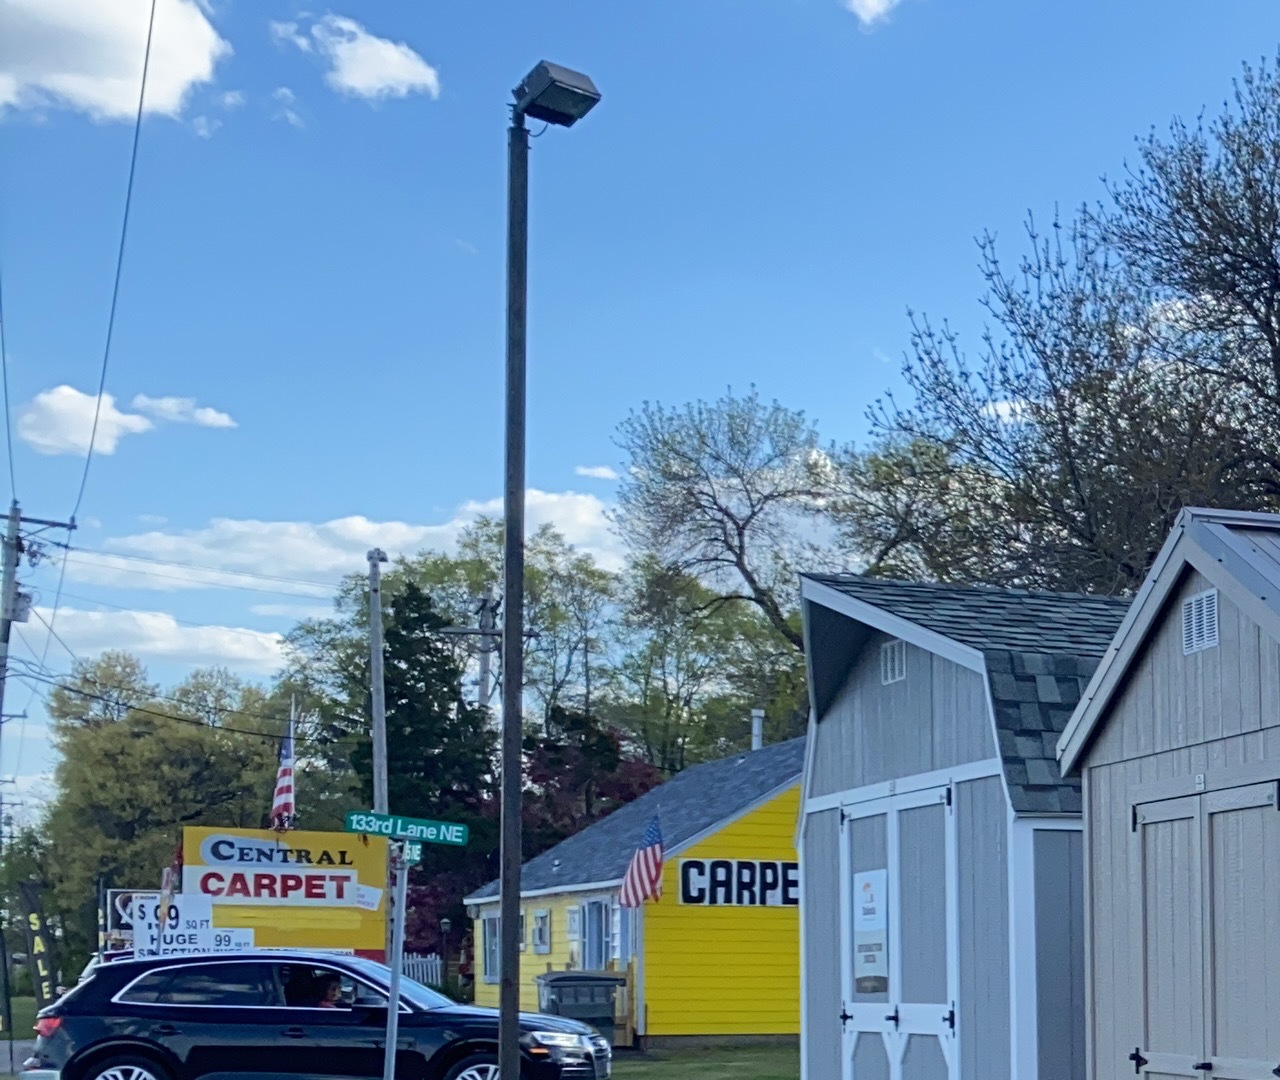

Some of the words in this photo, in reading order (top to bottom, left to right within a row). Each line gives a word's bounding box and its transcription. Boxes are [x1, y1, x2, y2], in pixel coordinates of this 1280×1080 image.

[350, 814, 393, 834] 133rd
[396, 819, 437, 839] Lane
[439, 825, 463, 842] NE
[199, 872, 351, 899] CARPET
[185, 920, 197, 929] SQ
[200, 920, 209, 929] FT
[150, 934, 198, 945] HUGE
[214, 934, 231, 947] 99
[28, 913, 51, 999] SALE
